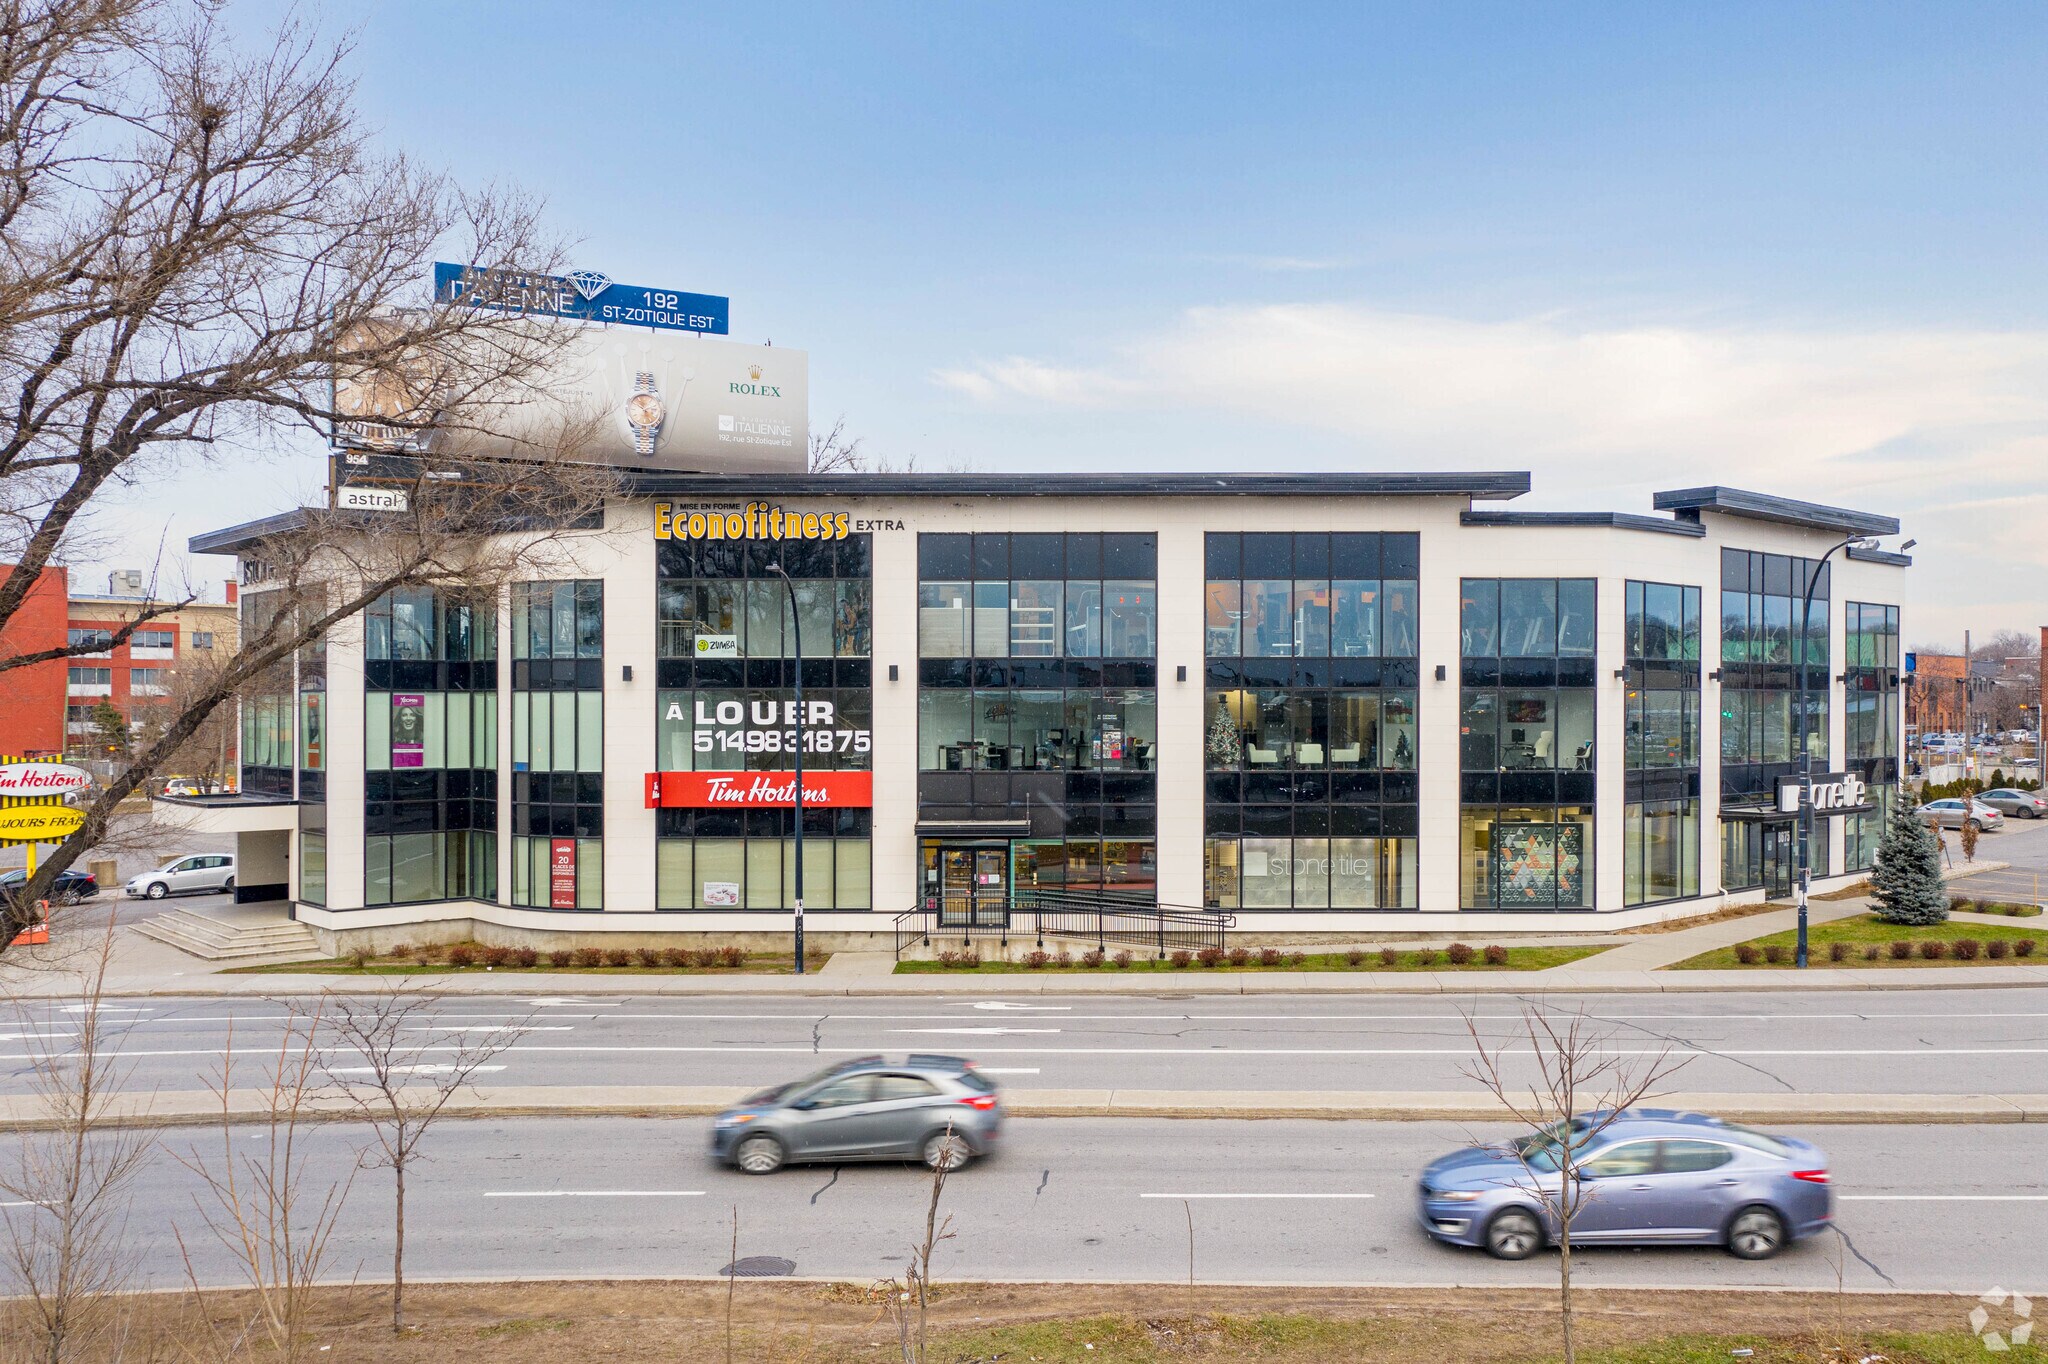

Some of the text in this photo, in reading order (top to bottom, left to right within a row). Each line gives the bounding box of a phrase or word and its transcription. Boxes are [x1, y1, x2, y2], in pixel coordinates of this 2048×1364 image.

[467, 271, 559, 289] BIOUTERIE
[643, 291, 678, 310] 192
[603, 305, 715, 329] ST-ZOTIQUE EST
[729, 382, 781, 398] ROLEX
[735, 421, 792, 437] ITALIENNE
[719, 433, 732, 443] 192,
[746, 436, 781, 446] St-Zotique
[782, 438, 792, 447] Est
[346, 454, 368, 465] 954
[348, 493, 398, 507] astral
[654, 501, 905, 541] Econofitness EXTRA
[710, 640, 735, 650] ZUMBA
[695, 700, 834, 726] LOUER
[20, 769, 83, 788] Hortons
[706, 777, 745, 802] Tim
[558, 856, 569, 864] 20
[1270, 852, 1368, 876] stone tile
